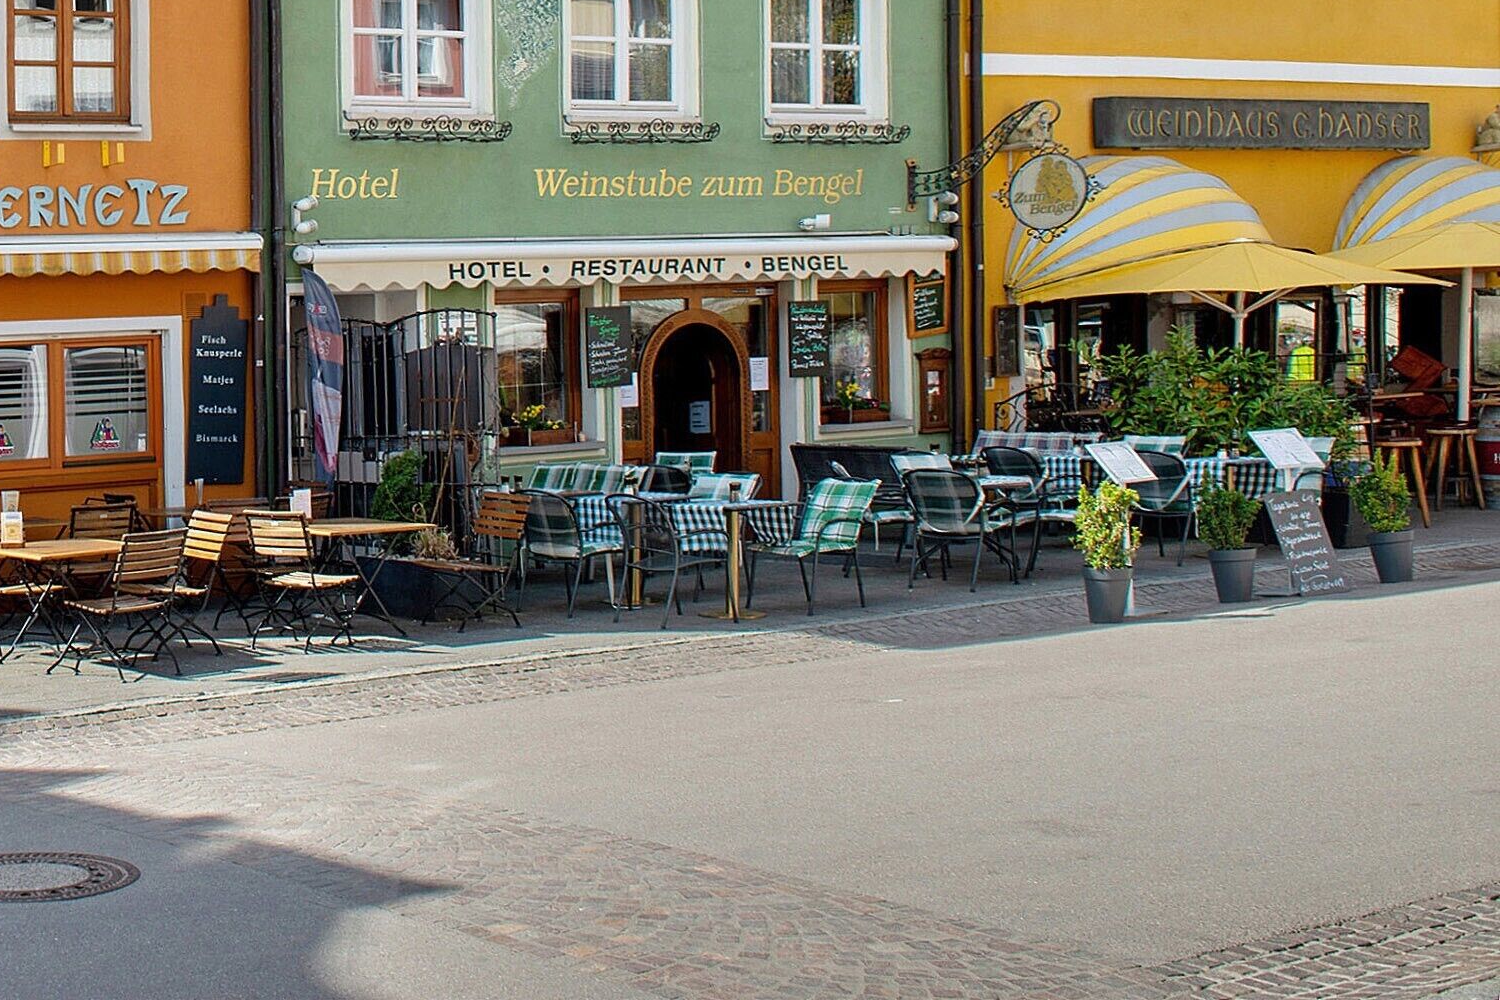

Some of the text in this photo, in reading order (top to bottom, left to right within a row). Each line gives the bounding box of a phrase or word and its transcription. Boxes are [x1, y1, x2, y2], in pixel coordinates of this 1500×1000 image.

[310, 168, 400, 199] Hotel
[533, 168, 865, 204] Weinstube zum Bengel
[1013, 192, 1045, 203] Zum
[1030, 199, 1076, 216] Bengel
[448, 254, 849, 279] HOTEL RESTAURANT BENGEL
[201, 335, 227, 344] Fisch
[196, 348, 242, 359] Knusperle
[202, 374, 234, 385] Matjes
[198, 404, 237, 414] Seelachs
[196, 433, 238, 443] Bismarck
